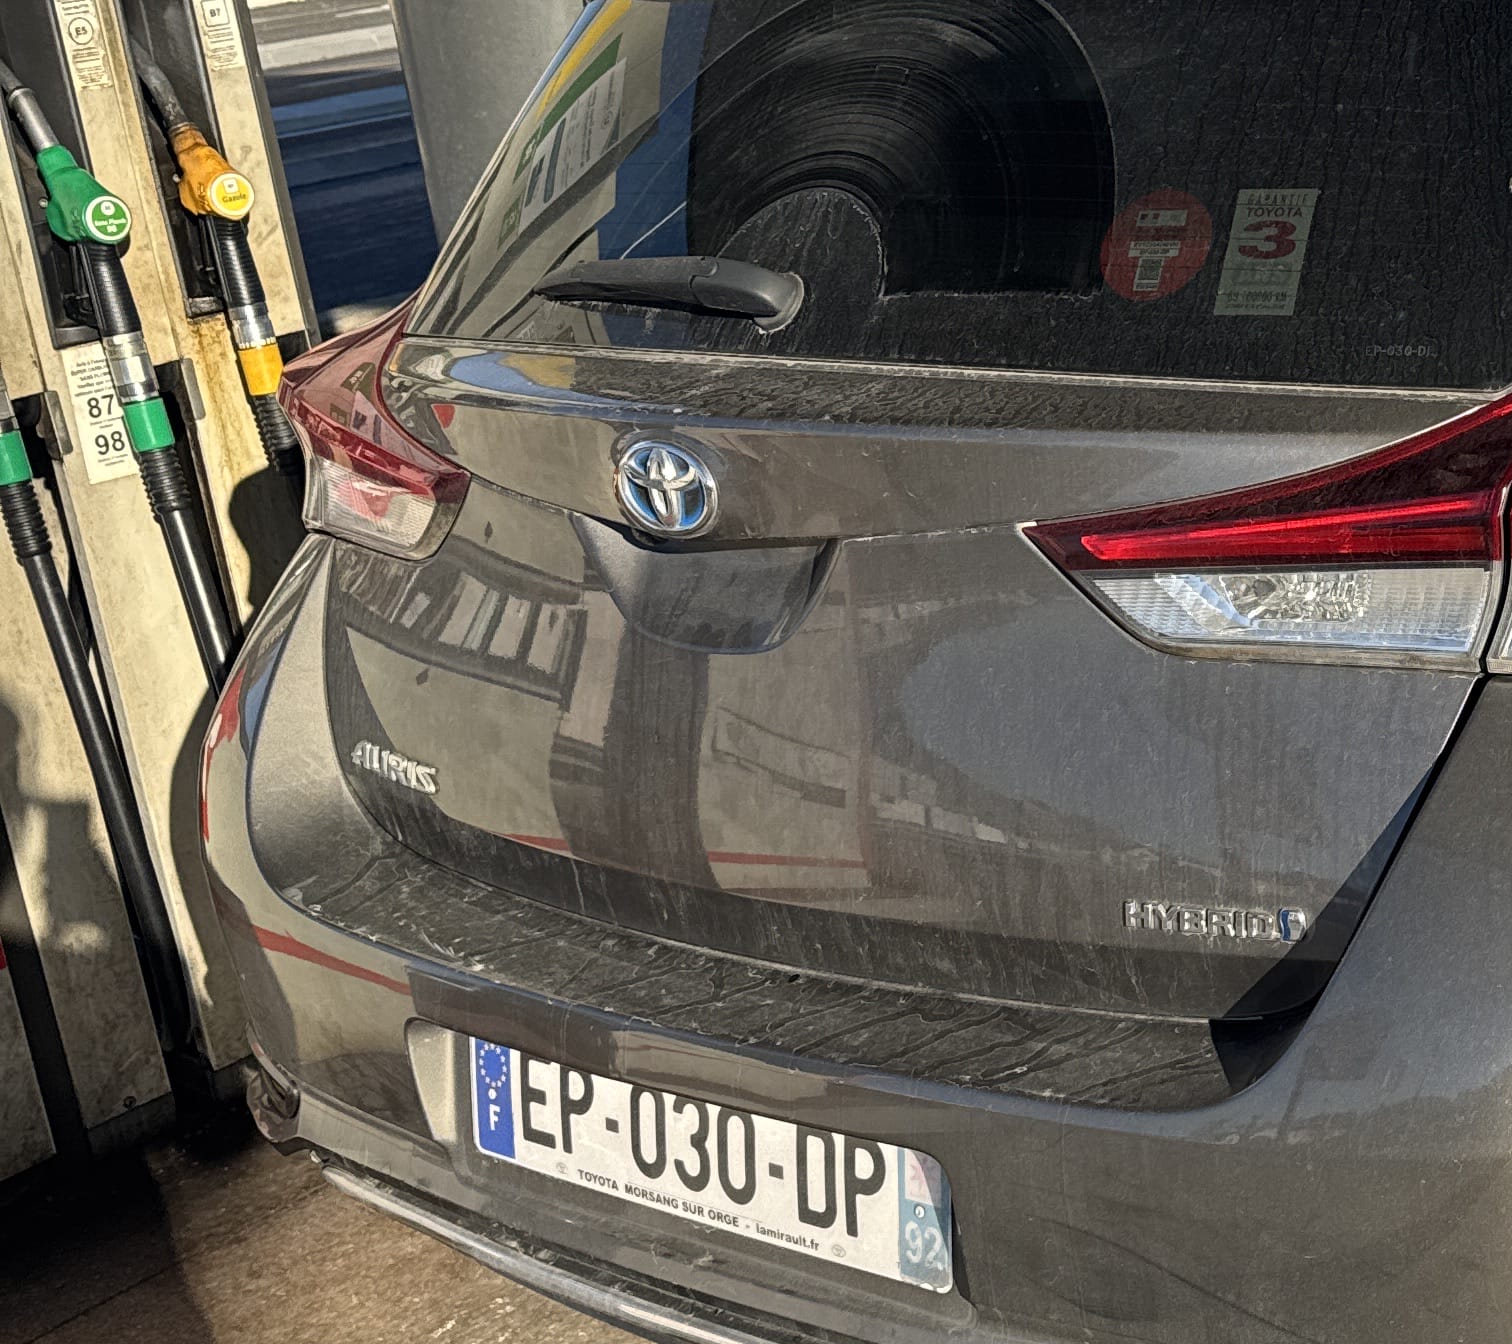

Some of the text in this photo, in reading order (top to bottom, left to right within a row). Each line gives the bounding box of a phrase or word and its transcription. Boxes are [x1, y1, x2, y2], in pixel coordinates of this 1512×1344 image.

[209, 8, 221, 17] B7
[74, 26, 88, 36] E5
[222, 193, 247, 204] Gazole
[1247, 207, 1303, 218] TOYOTA
[1238, 220, 1297, 260] 3
[87, 394, 114, 418] 87
[95, 430, 125, 455] 98
[351, 739, 437, 794] AURIS
[1124, 899, 1275, 941] HYBRID
[489, 1104, 501, 1132] F
[519, 1056, 887, 1238] EP-030-DP
[577, 1168, 619, 1191] TOYOTA
[624, 1183, 679, 1209] MORSANG
[682, 1198, 705, 1218] SUR
[707, 1208, 740, 1228] ORGE
[756, 1222, 820, 1251] lamirault.fr
[905, 1219, 943, 1268] 92
